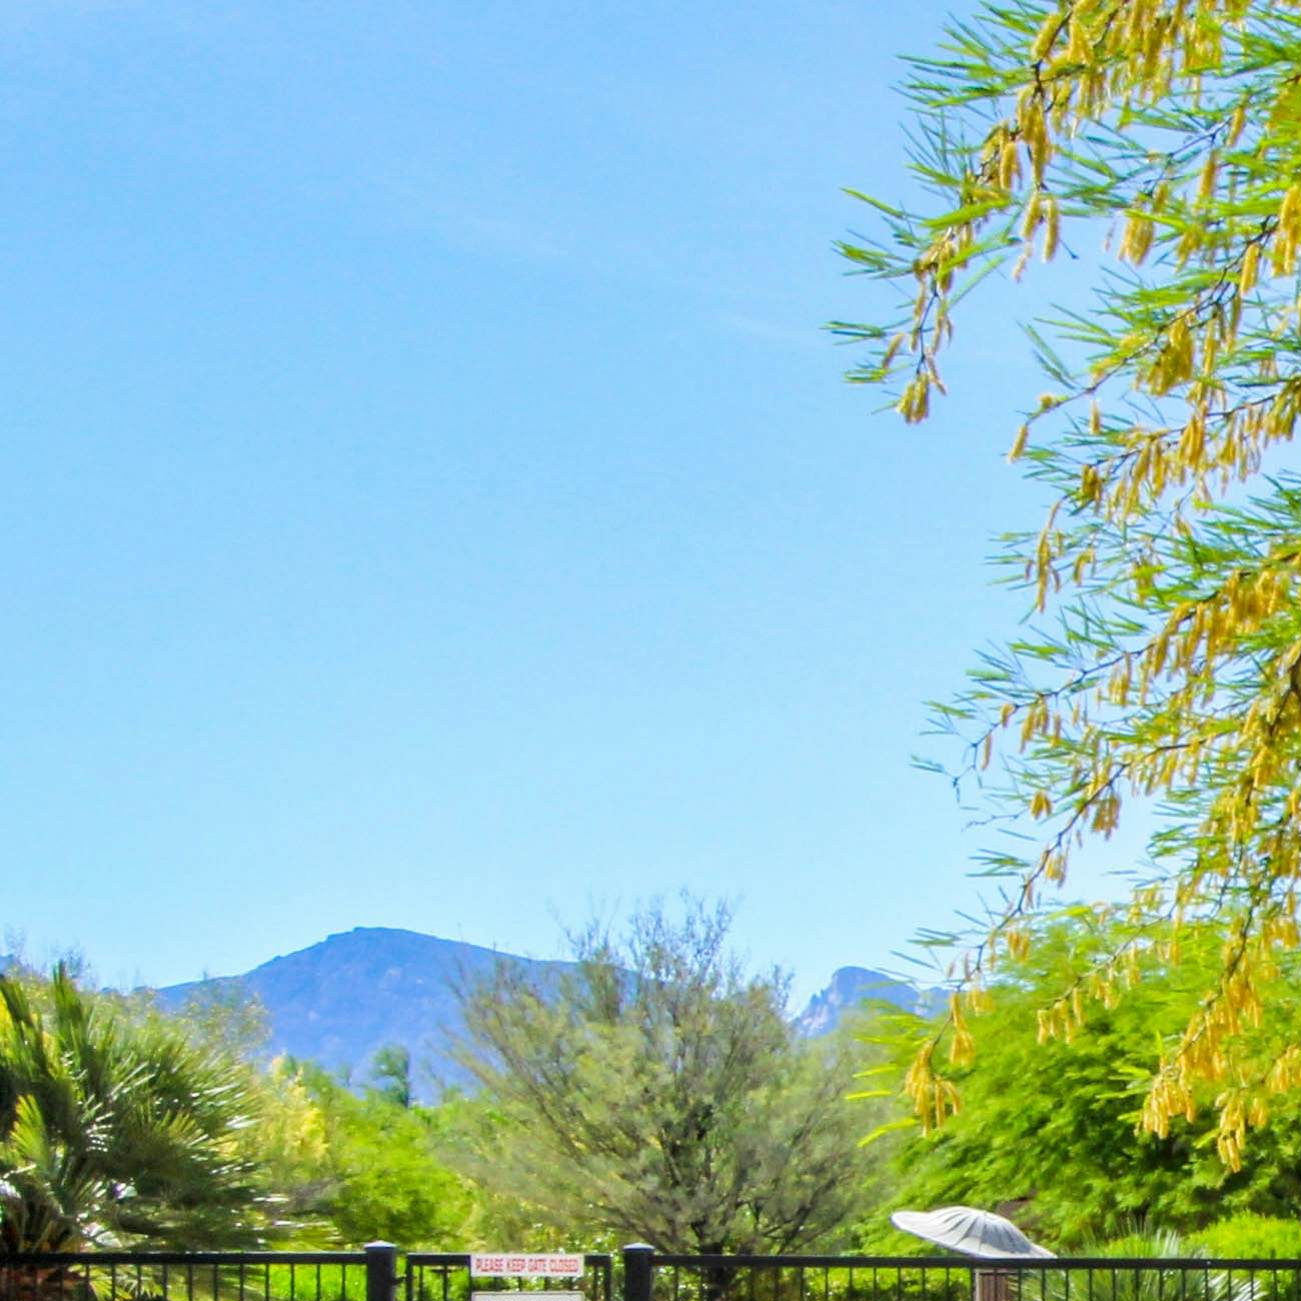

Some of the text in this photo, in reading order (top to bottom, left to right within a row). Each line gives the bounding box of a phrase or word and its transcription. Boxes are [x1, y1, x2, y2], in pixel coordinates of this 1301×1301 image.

[475, 1258, 579, 1273] PLEASE KEEP GATE CLOSED
